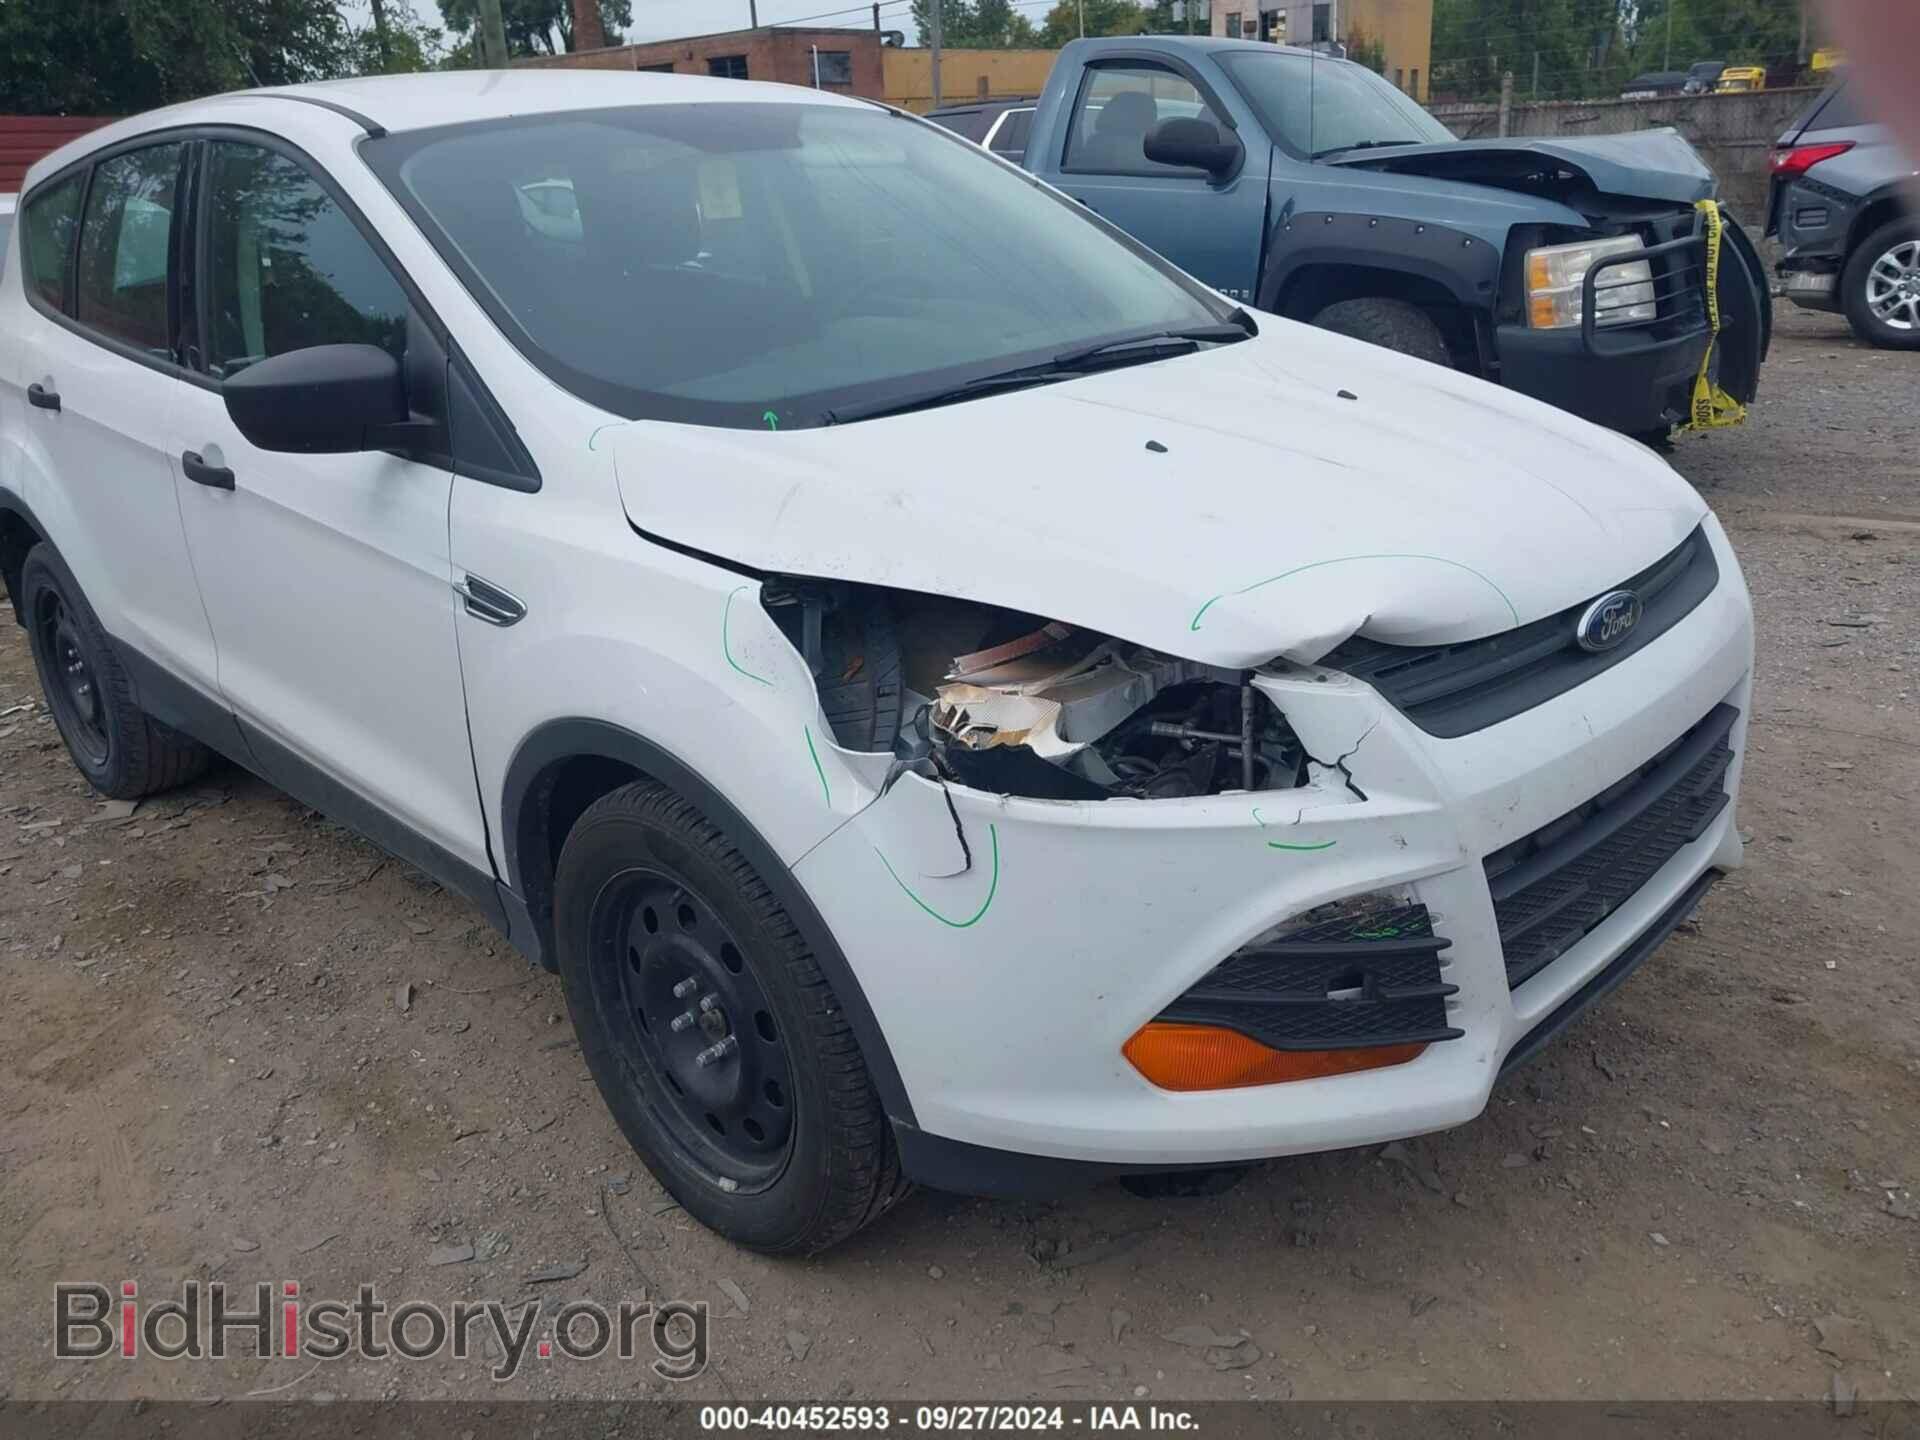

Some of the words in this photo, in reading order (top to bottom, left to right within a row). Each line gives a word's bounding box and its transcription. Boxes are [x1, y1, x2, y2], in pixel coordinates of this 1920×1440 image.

[1706, 243, 1716, 263] NOT
[1695, 399, 1712, 427] CROSS
[1600, 600, 1633, 641] Ford
